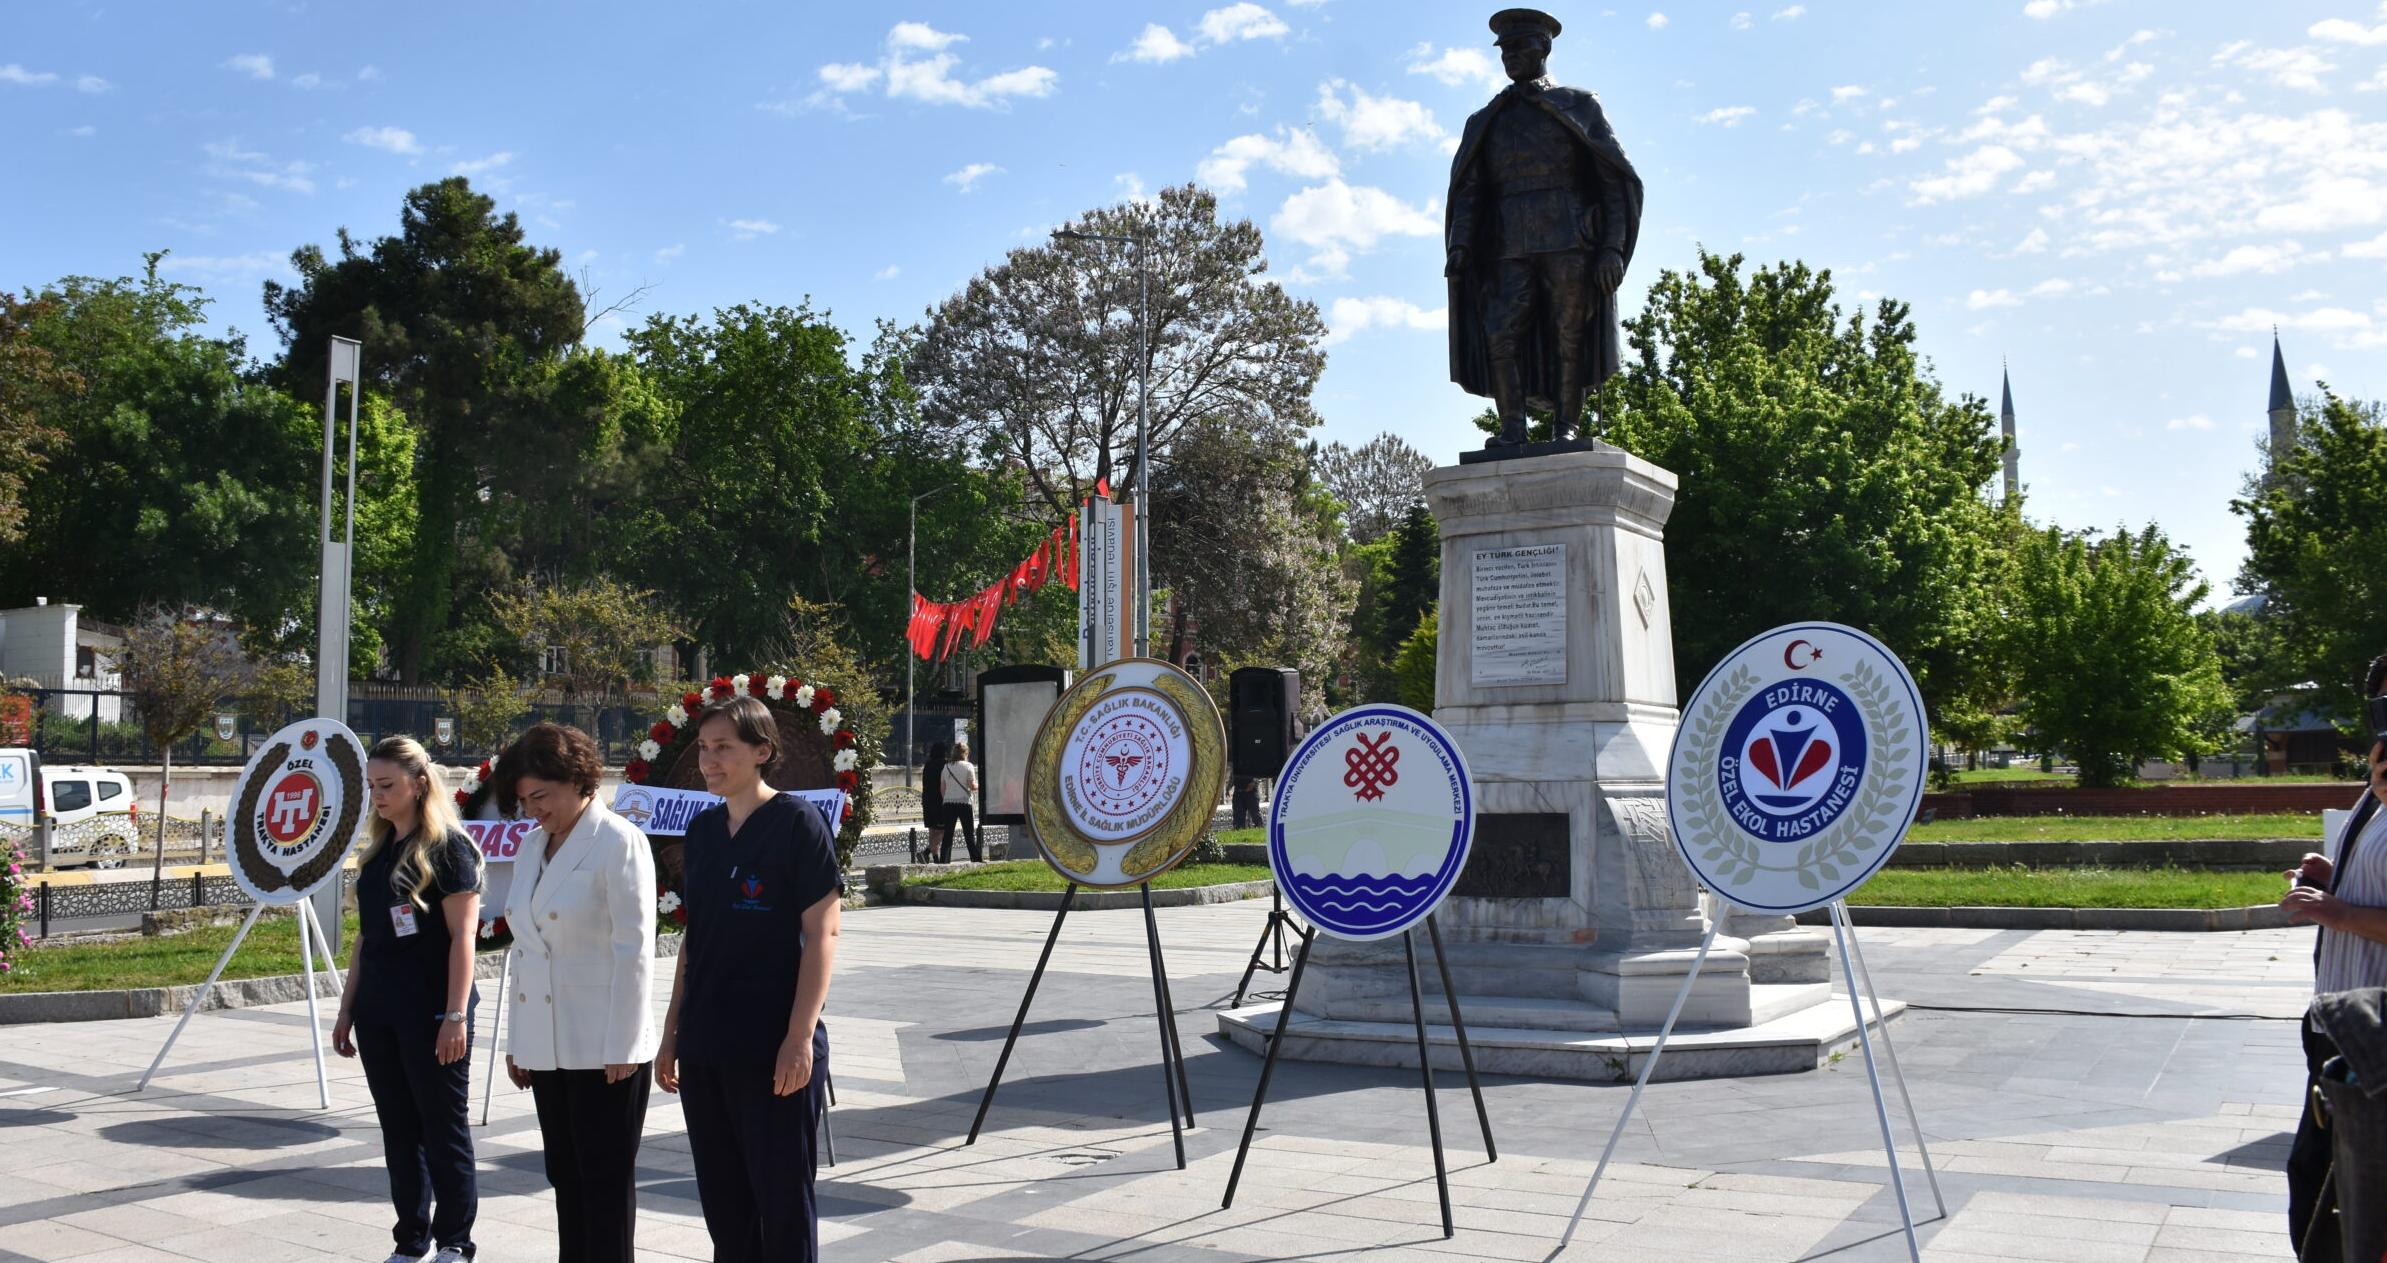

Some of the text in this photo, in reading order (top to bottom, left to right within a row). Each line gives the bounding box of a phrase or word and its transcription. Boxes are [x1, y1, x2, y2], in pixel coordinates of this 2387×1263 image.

[1490, 551, 1513, 559] TÜRK
[1765, 682, 1839, 713] EDİRNE
[1089, 698, 1129, 725] SAĞLIK
[1132, 698, 1181, 739] BAKANLIĞI
[287, 759, 314, 771] ÖZEL
[1280, 718, 1463, 818] TRAKYA ÜNİVERSİTESİ SAĞLIK ARAŞTIRMA VE UYGULAMA MERKEZİ
[651, 793, 704, 830] SAĞLIK
[1065, 775, 1083, 814] EDİRNE
[1080, 809, 1088, 822] İL
[1088, 816, 1124, 832] SAĞLIK
[1721, 756, 1859, 838] ÖZEL EKOL HASTANESİ
[256, 811, 278, 855] TRAKYA
